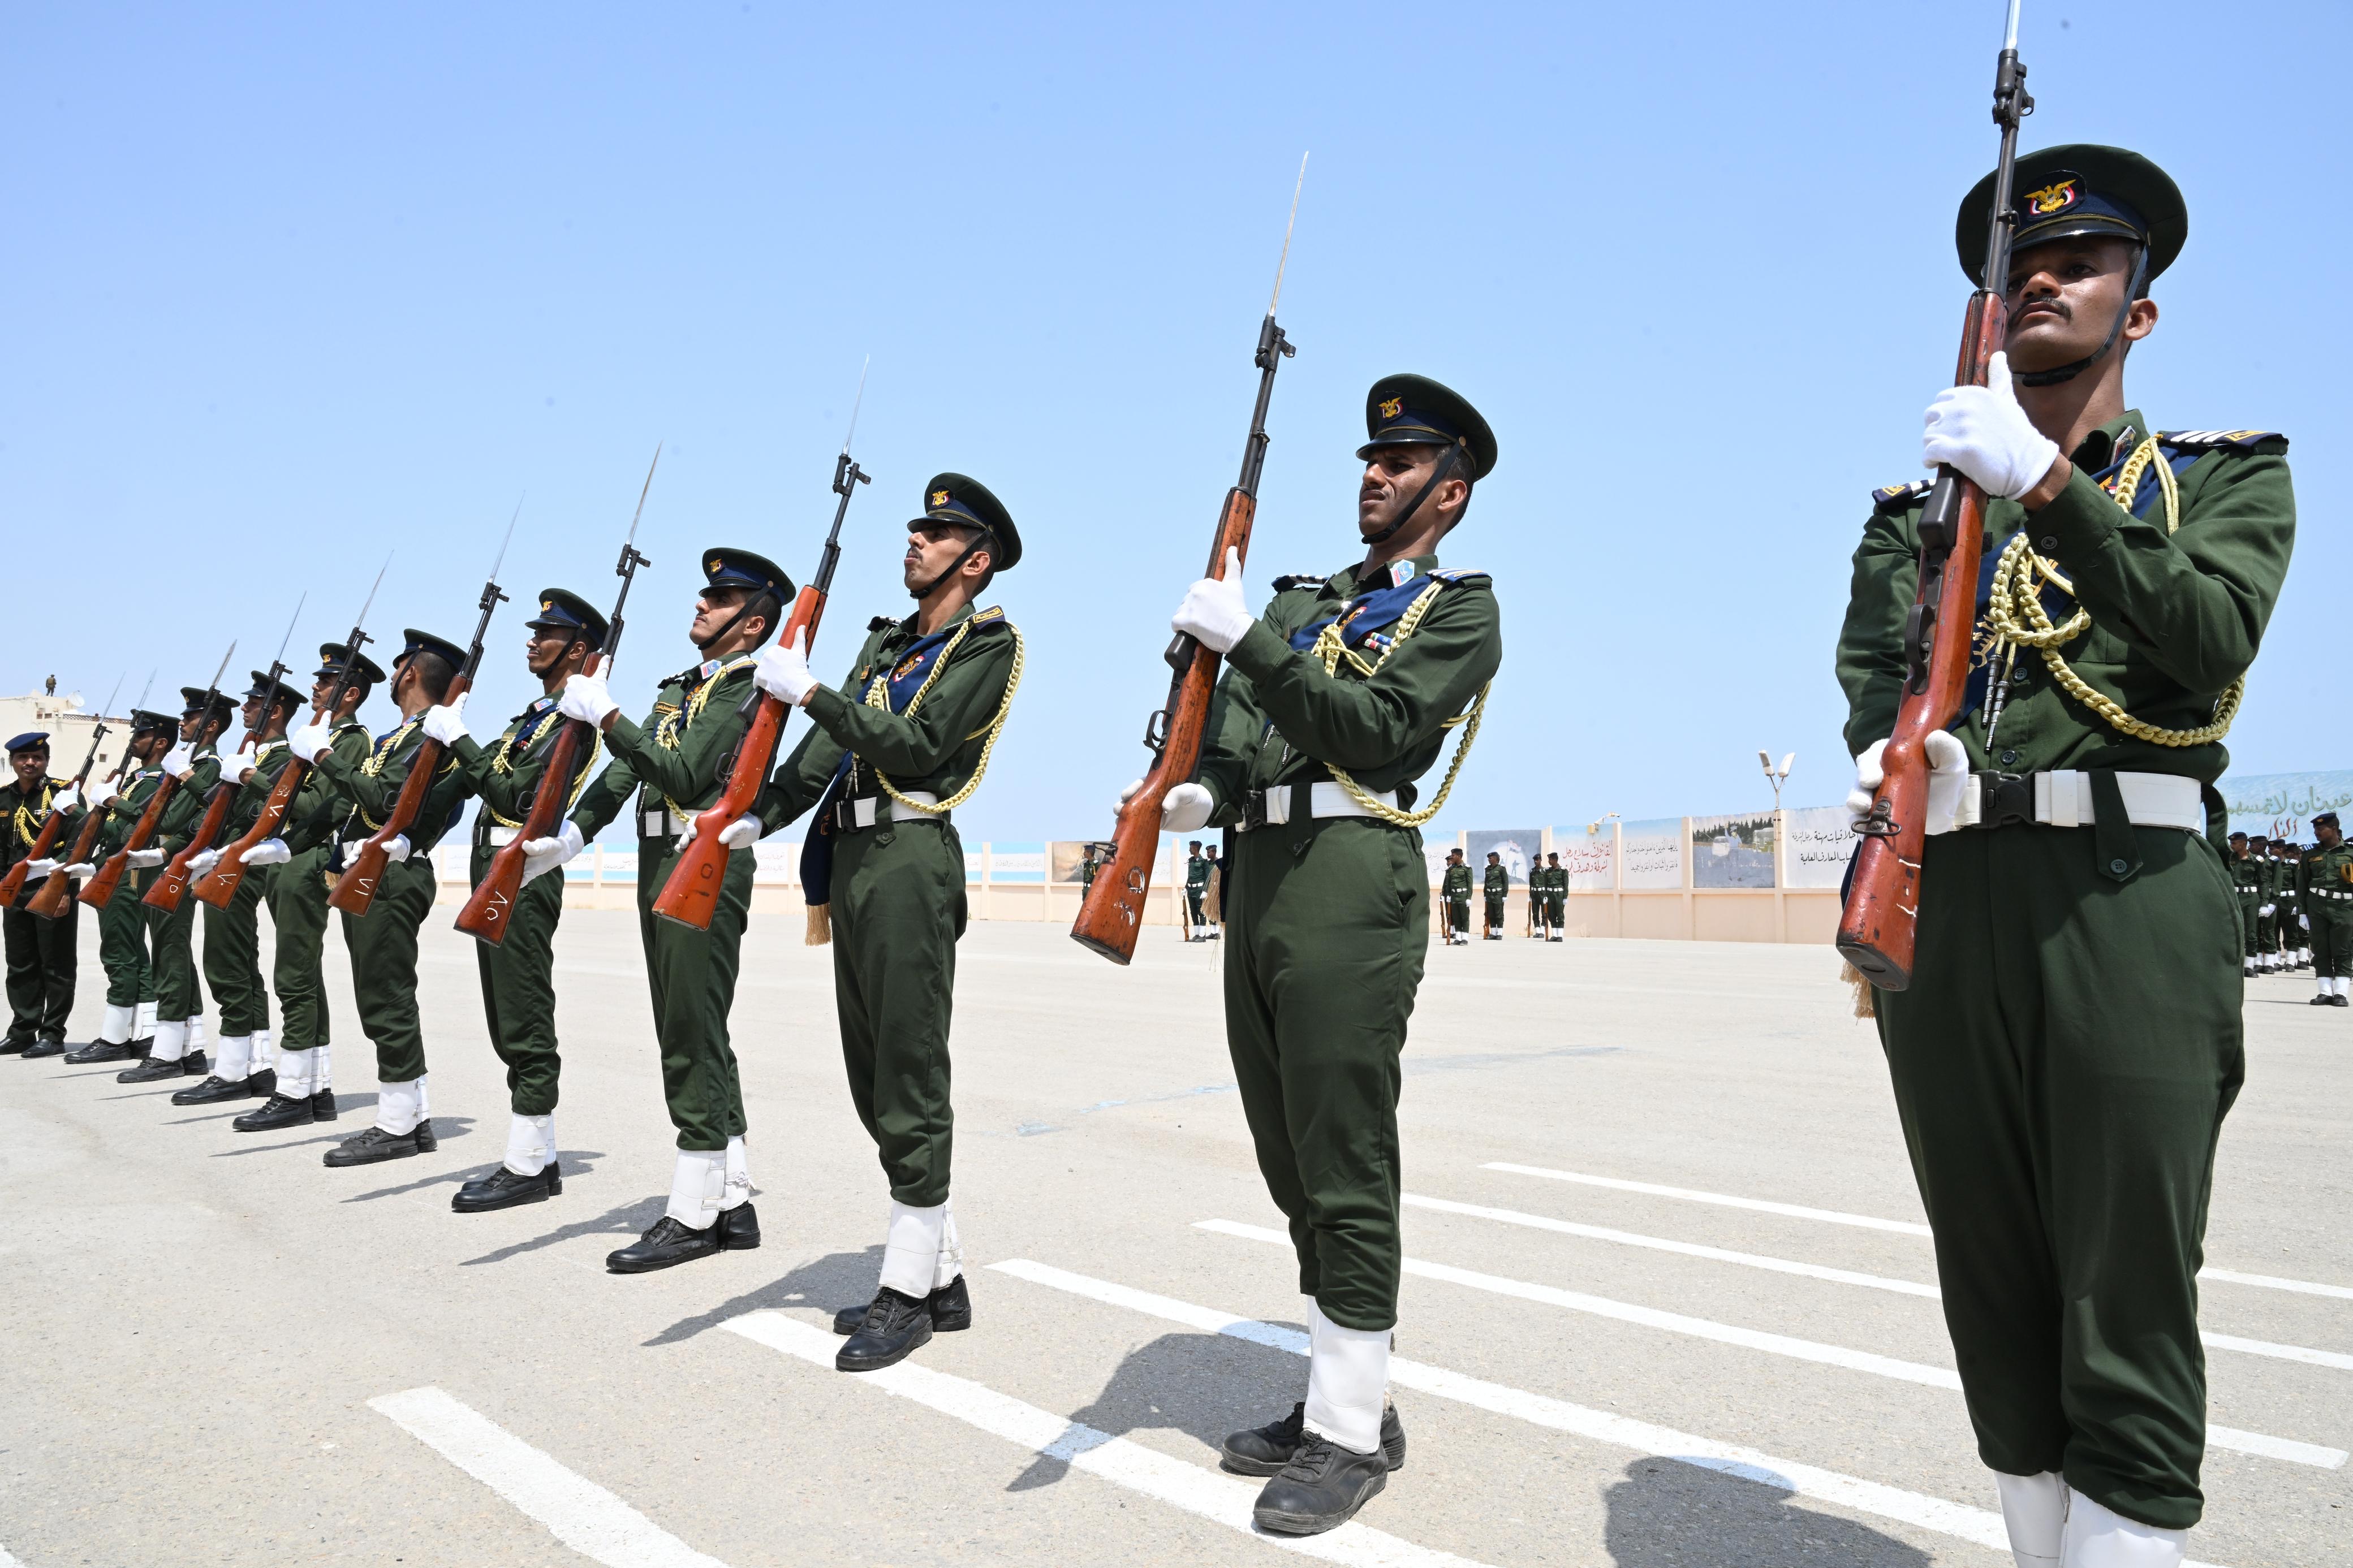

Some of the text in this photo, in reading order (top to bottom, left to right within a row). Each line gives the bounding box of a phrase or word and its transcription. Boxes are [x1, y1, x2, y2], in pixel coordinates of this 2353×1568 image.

[2271, 791, 2288, 815] لا
[2291, 785, 2352, 816] عينان
[2267, 817, 2298, 840] النار
[1814, 831, 1828, 845] مهنة
[1590, 840, 1613, 858] القانون
[1800, 851, 1818, 865] العلمية
[1817, 850, 1839, 862] المعارف
